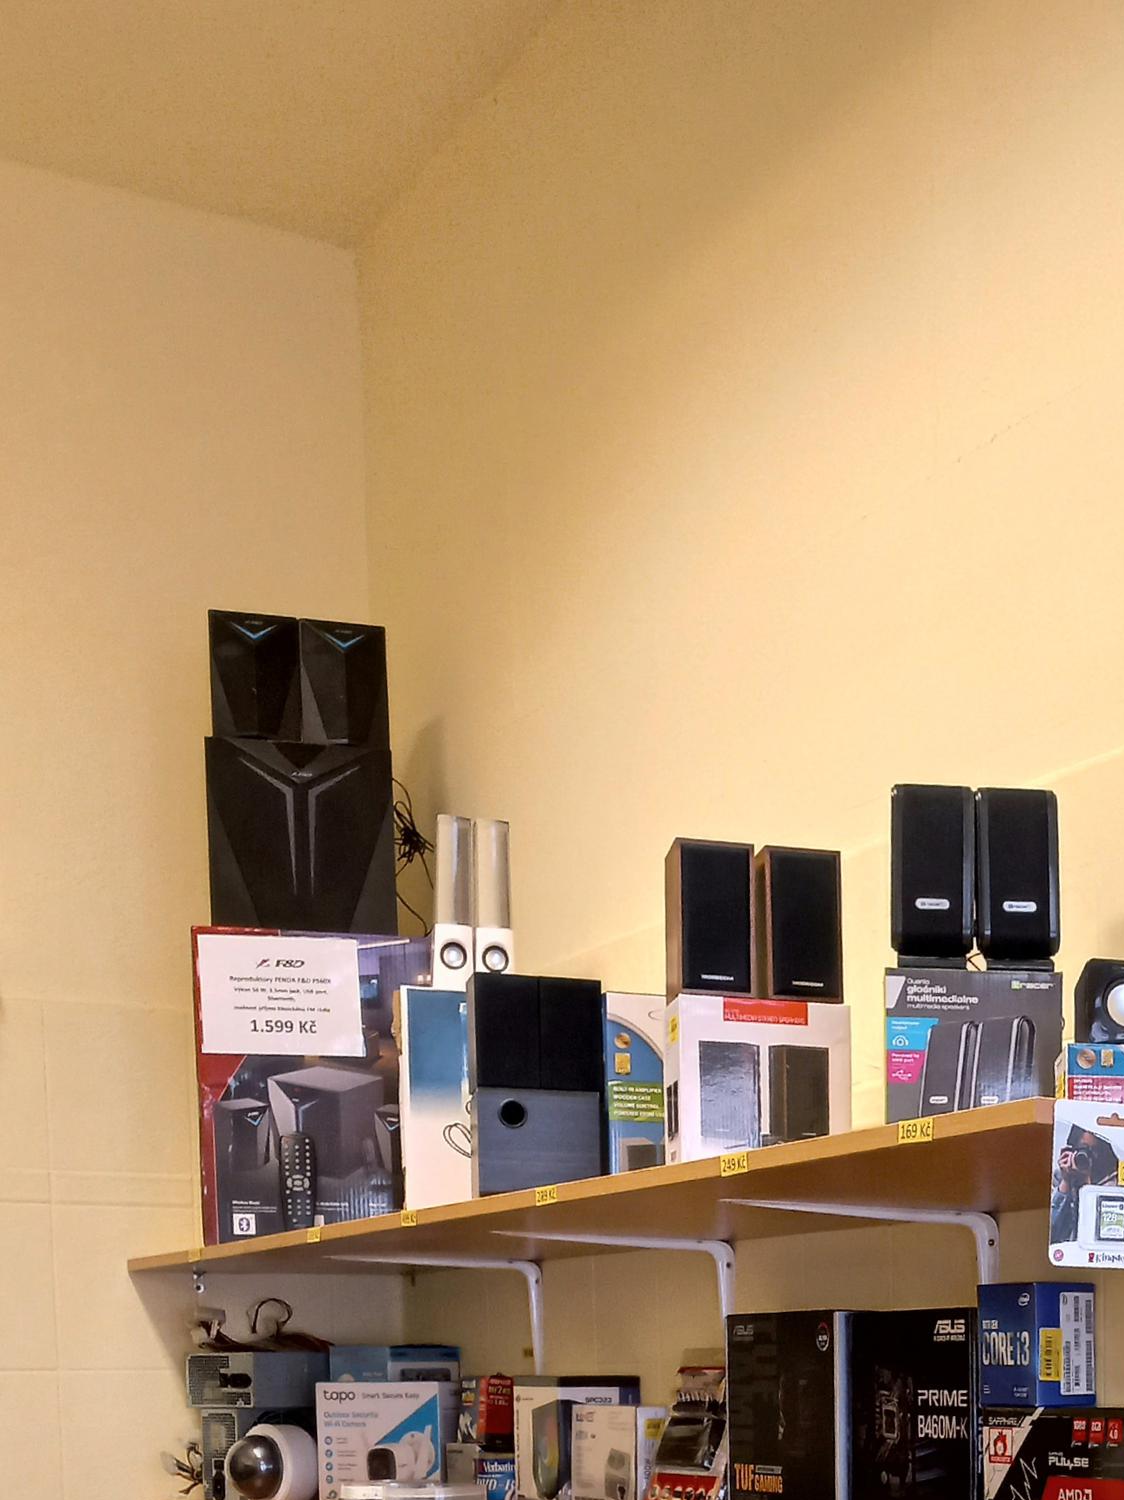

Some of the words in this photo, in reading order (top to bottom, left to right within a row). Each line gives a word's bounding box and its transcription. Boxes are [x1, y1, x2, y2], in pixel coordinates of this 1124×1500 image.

[275, 959, 305, 969] F&D
[906, 994, 980, 1004] multimedialne
[250, 1019, 294, 1034] 1.599
[299, 1020, 318, 1034] Kč
[900, 1123, 918, 1140] 169
[919, 1121, 931, 1138] Kč
[721, 1157, 736, 1173] 249
[737, 1154, 747, 1170] Kč
[934, 1319, 966, 1334] ASUS
[982, 1332, 1014, 1366] CORE
[1016, 1331, 1030, 1366] i3
[323, 1390, 356, 1404] tapo
[917, 1390, 968, 1407] PRIME
[917, 1415, 968, 1439] B460M-K
[735, 1464, 754, 1490] TUF
[755, 1474, 783, 1493] GAMING
